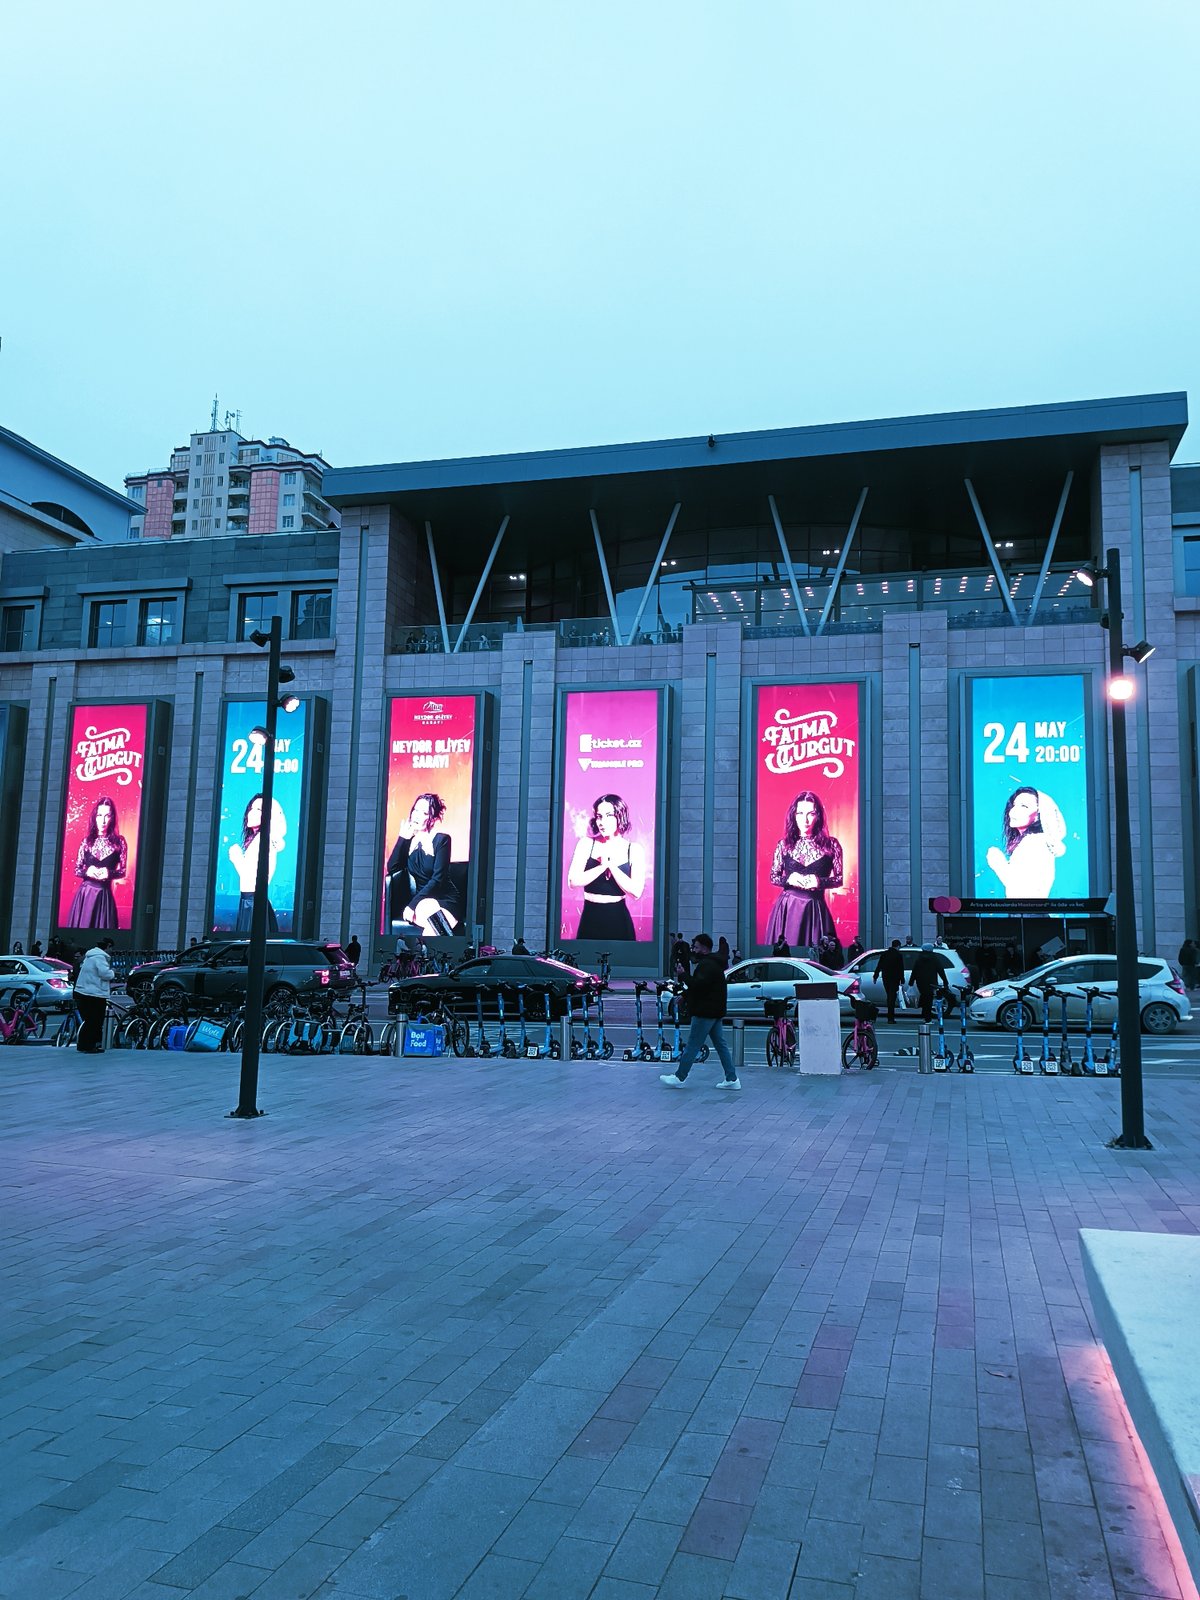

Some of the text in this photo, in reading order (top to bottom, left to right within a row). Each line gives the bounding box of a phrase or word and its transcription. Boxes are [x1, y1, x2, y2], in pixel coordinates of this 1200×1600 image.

[762, 718, 831, 746] FATMA
[983, 721, 1067, 764] 24 MAY
[75, 734, 125, 758] FATMA
[231, 738, 265, 774] 24
[775, 737, 855, 769] TURGUT
[1035, 745, 1080, 763] 20:00
[82, 751, 142, 779] TURGUT
[274, 758, 299, 773] 0:00
[202, 1025, 220, 1037] Wolt
[410, 1031, 425, 1039] Bolt
[410, 1039, 427, 1047] Food
